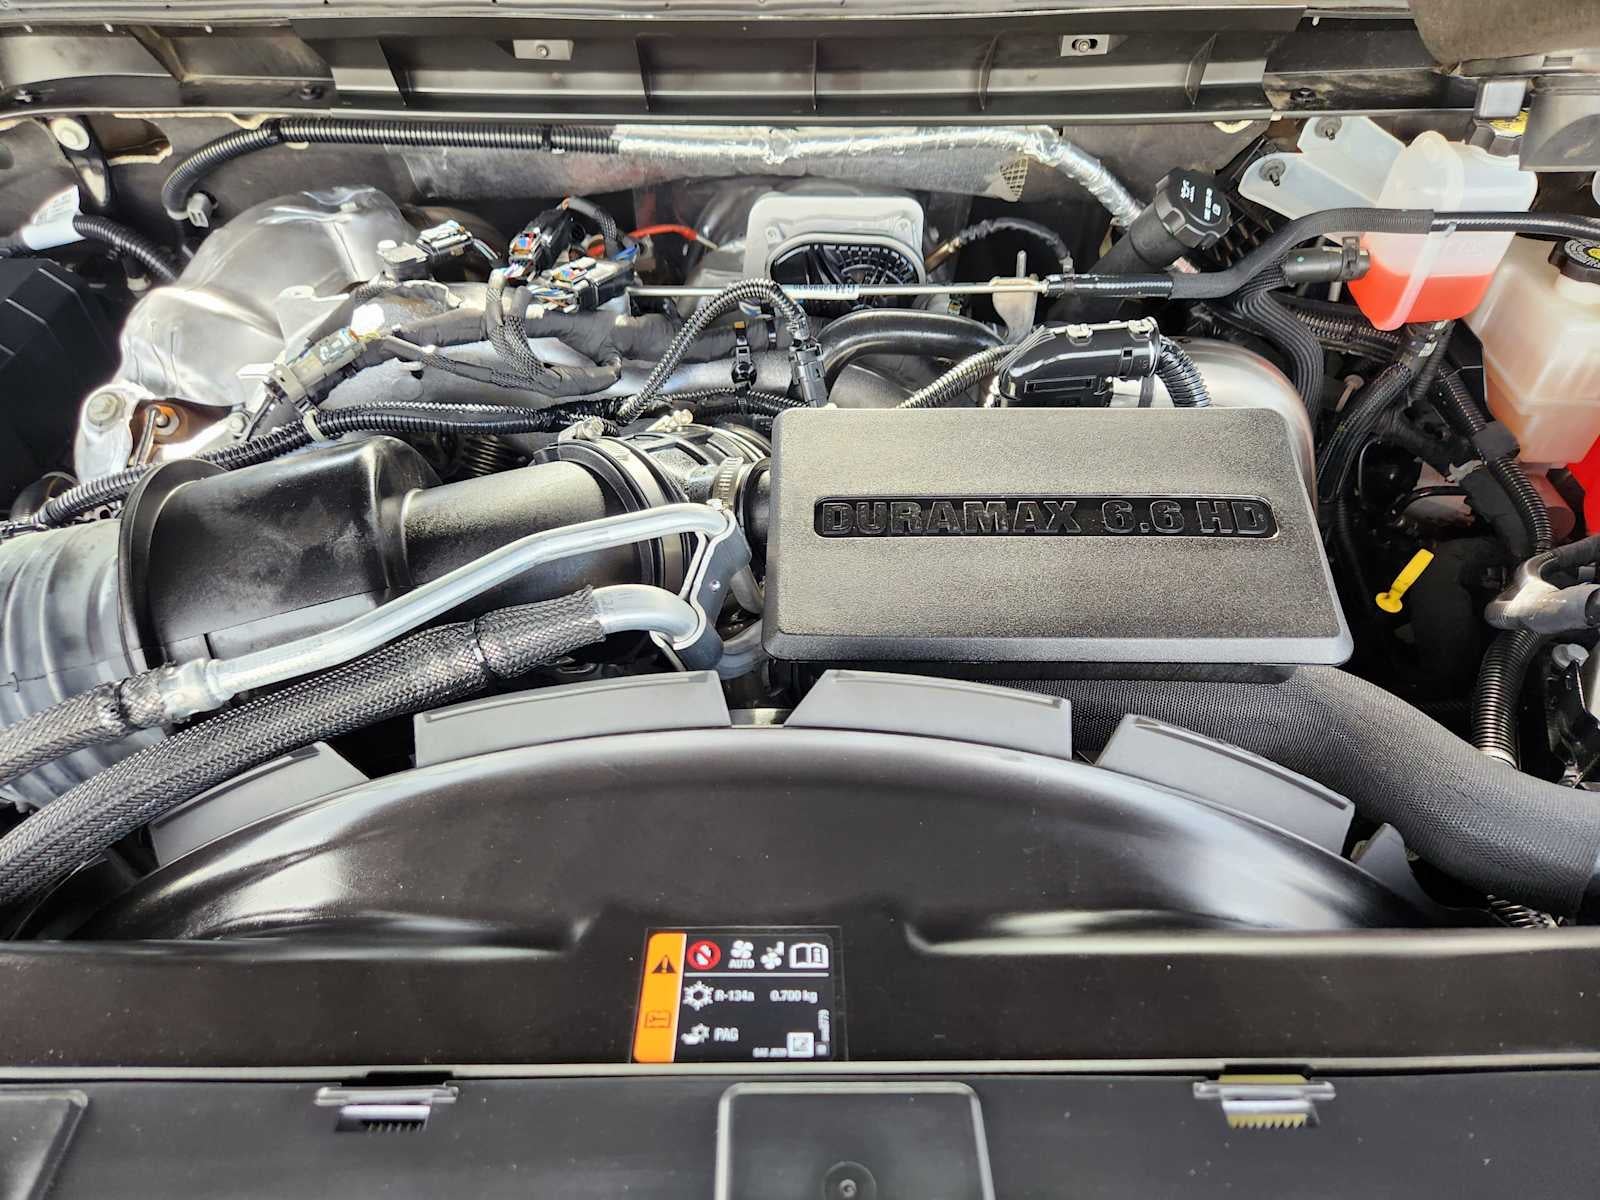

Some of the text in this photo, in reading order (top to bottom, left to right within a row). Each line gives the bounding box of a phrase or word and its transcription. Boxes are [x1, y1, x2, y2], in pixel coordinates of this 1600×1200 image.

[822, 499, 1271, 534] DURAMAX 6.6 HD
[728, 958, 755, 969] AUTO
[714, 989, 755, 1002] R-134a
[802, 989, 818, 1004] kg
[713, 1027, 739, 1042] PAG
